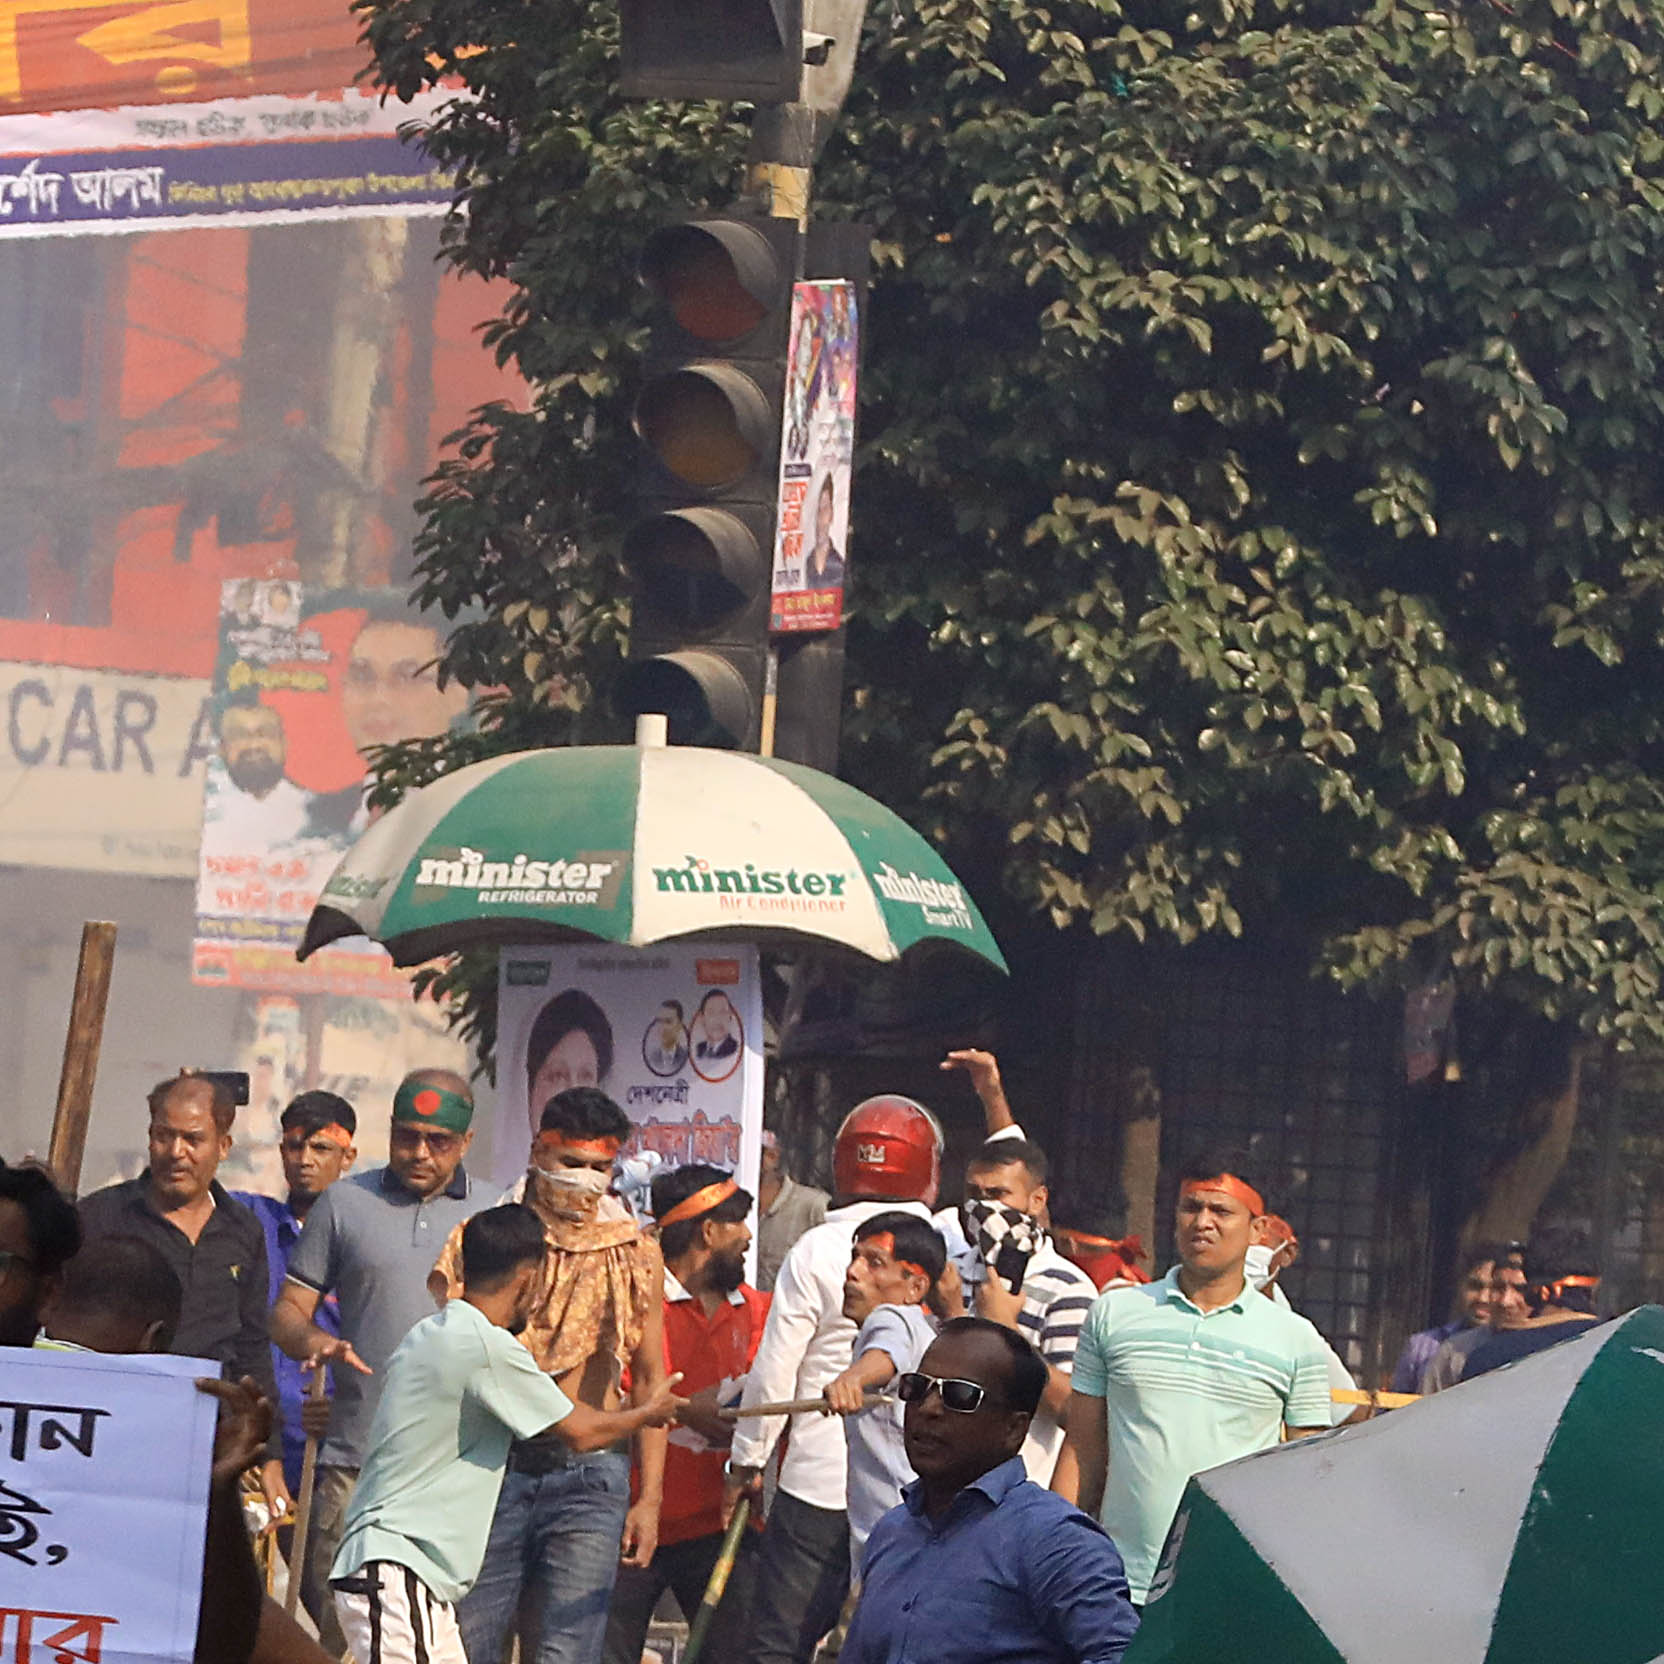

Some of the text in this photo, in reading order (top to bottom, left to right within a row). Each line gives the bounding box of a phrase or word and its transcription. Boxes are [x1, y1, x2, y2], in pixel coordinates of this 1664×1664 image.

[69, 166, 166, 212] আলম
[8, 679, 158, 773] CAR
[416, 847, 612, 889] minister
[652, 855, 846, 896] minister
[478, 890, 599, 904] REFRIGERATOR
